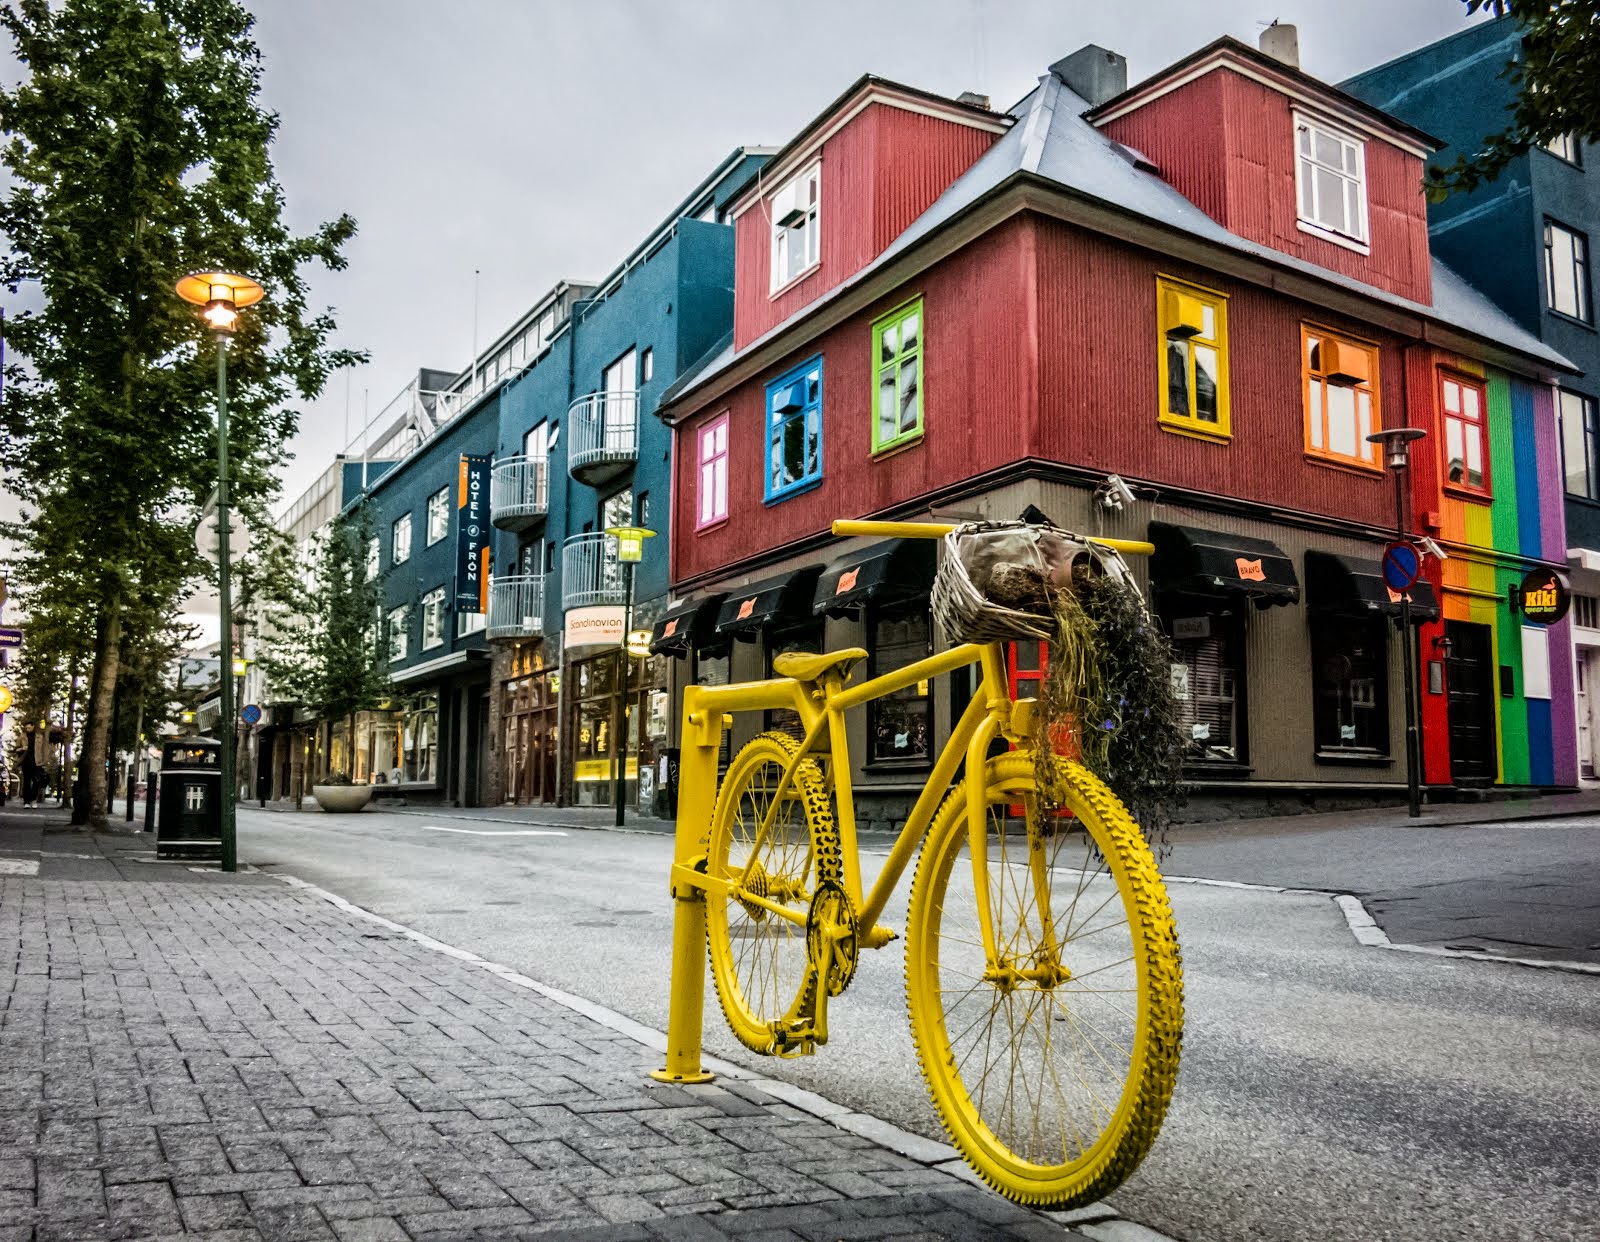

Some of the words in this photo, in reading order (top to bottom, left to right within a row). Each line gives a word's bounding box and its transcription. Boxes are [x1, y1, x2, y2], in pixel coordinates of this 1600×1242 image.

[467, 542, 477, 581] FRÓN
[1240, 566, 1260, 574] BRAVO
[1525, 589, 1556, 606] Kiki
[570, 618, 622, 629] Scandinavian
